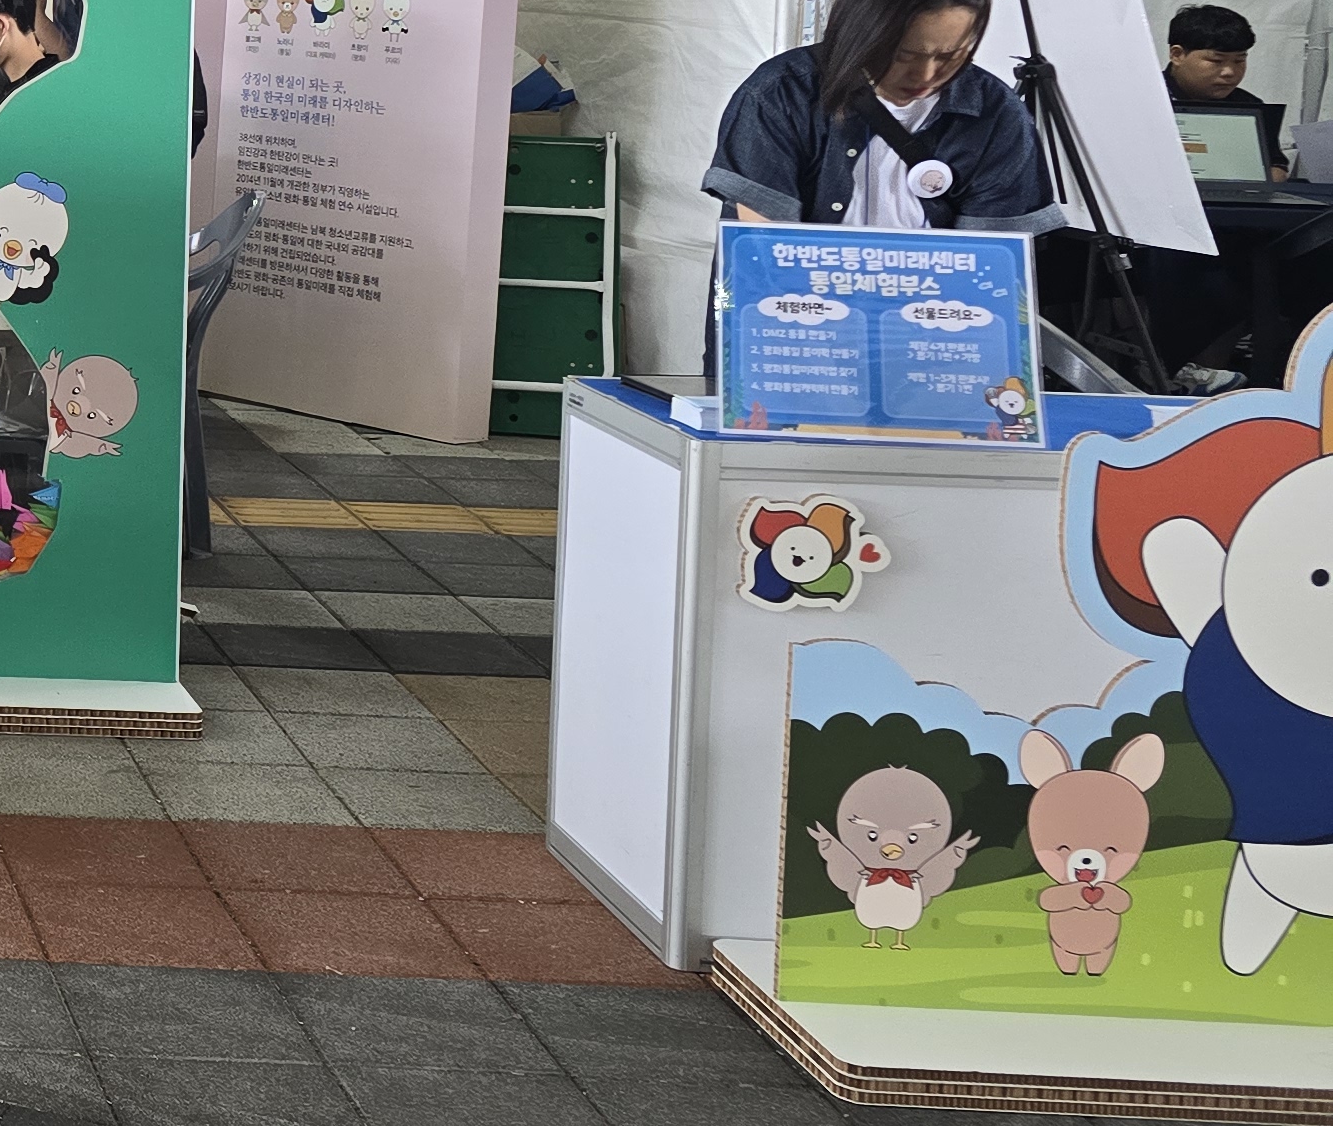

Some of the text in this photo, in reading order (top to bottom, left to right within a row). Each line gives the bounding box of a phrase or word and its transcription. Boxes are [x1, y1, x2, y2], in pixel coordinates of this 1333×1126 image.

[241, 72, 347, 95] 상징이 현실이 되는 곳,
[241, 88, 386, 115] 통일 한국의 미래를 디자인하는
[240, 104, 335, 127] 한반도통일미래센터!
[236, 159, 313, 179] 한반도통일미래센터는
[269, 149, 300, 164] 한탄강이
[302, 154, 326, 167] 만나는
[235, 173, 261, 186] 2014년
[311, 182, 336, 196] 정부가
[337, 185, 371, 201] 직영하는
[320, 197, 336, 210] 체험
[338, 200, 354, 212] 연수
[355, 202, 400, 219] 시설입니다.
[306, 238, 323, 250] 대한
[324, 241, 350, 254] 국내외
[351, 245, 384, 260] 공감대를
[771, 242, 977, 273] 한반도통일미래센터
[808, 271, 942, 297] 통일체험부스
[775, 300, 833, 315] 체험하면~
[913, 307, 982, 321] 선물드려요~
